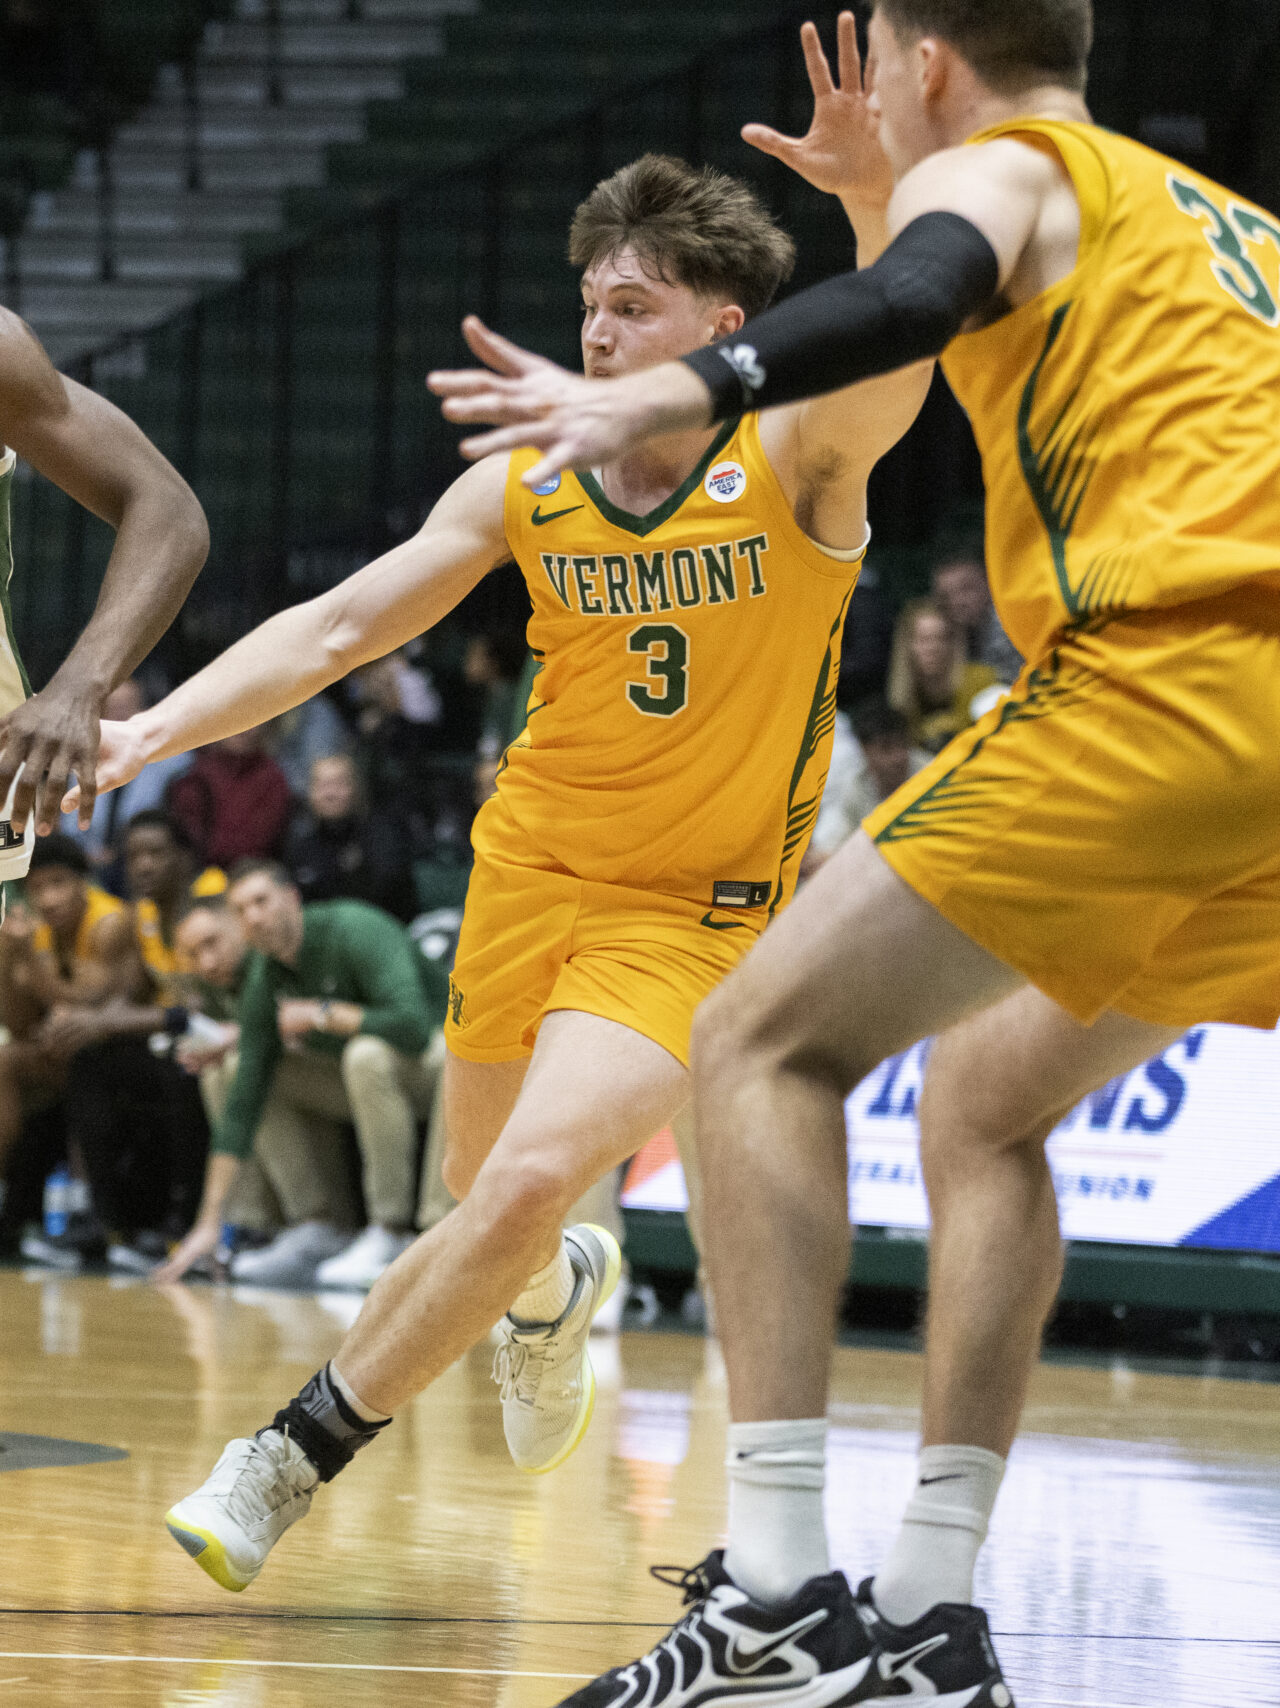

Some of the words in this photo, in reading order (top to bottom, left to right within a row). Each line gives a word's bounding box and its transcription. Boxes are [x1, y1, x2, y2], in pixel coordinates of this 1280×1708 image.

[709, 472, 743, 488] AMERICA
[716, 481, 736, 491] EAST
[540, 532, 769, 616] VERMONT
[626, 622, 690, 718] 3
[754, 890, 762, 901] L
